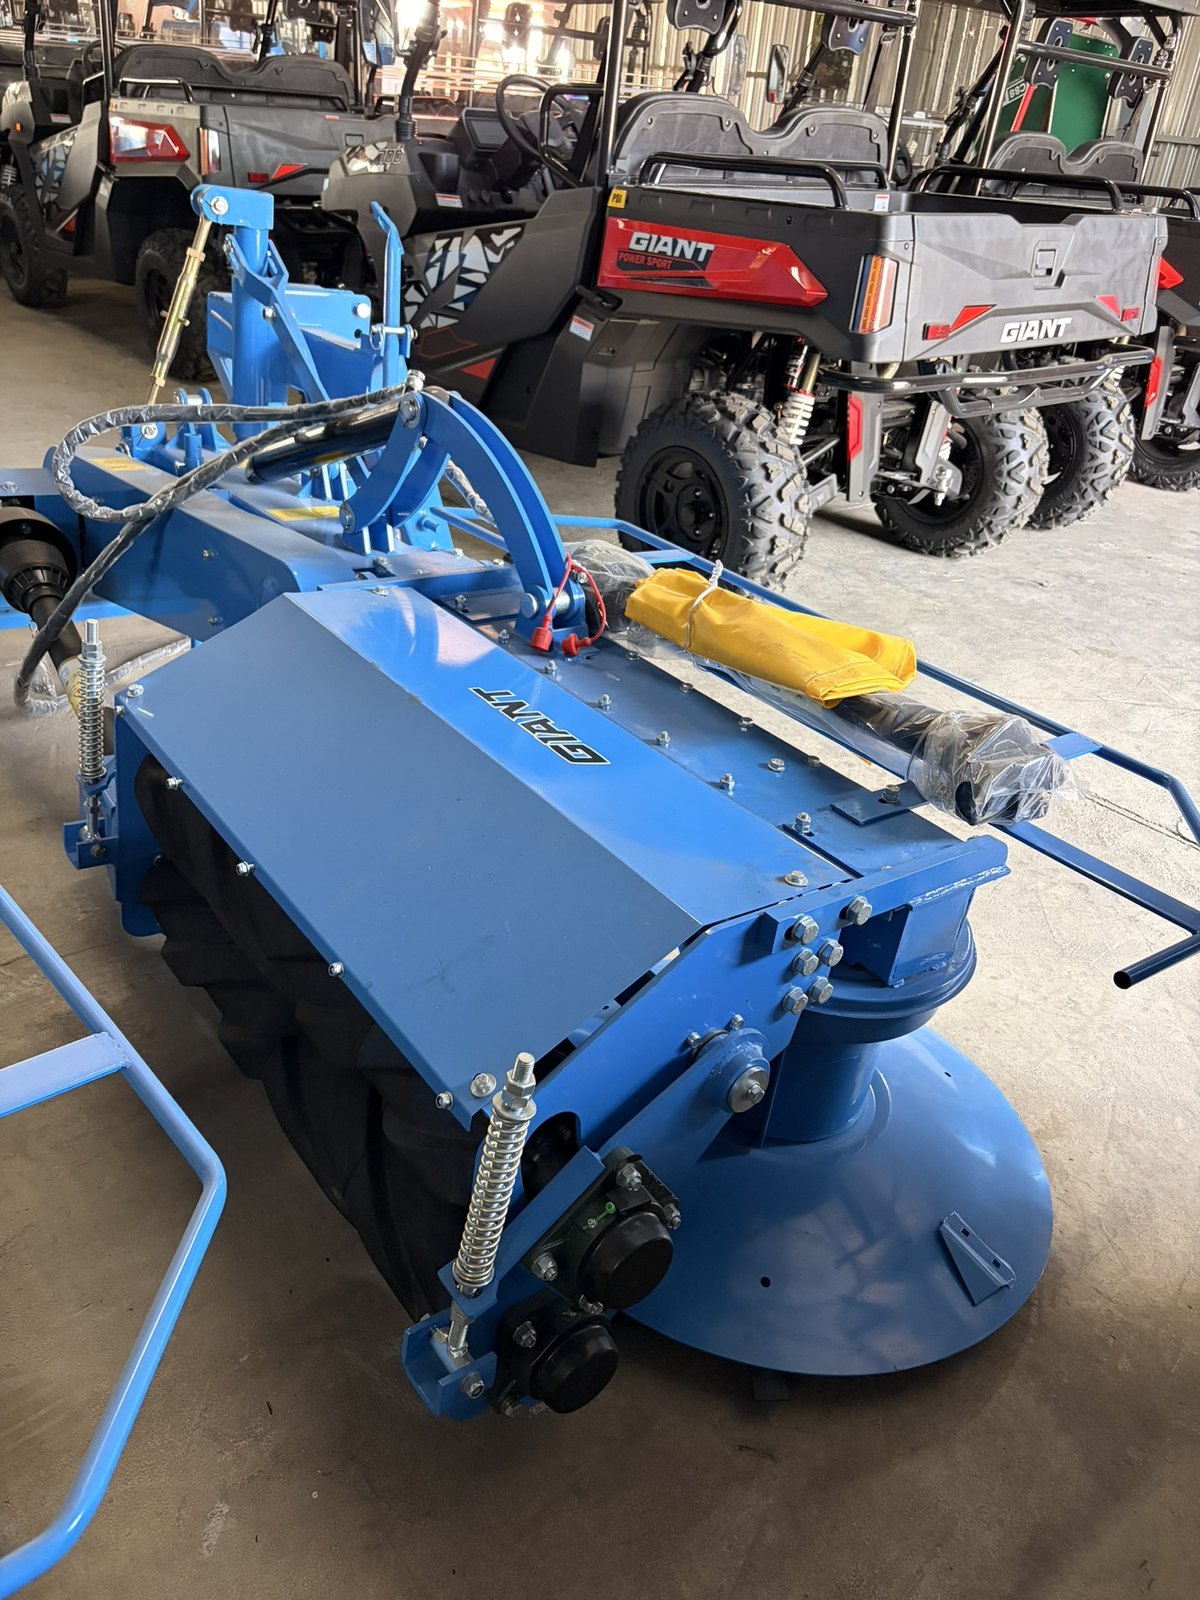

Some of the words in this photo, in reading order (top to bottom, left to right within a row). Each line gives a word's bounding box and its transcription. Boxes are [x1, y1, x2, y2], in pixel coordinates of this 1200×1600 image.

[619, 252, 645, 265] POWER
[646, 256, 672, 269] SPORT
[629, 232, 715, 262] GIANT
[1000, 317, 1072, 343] GIANT
[469, 687, 611, 764] GIANT
